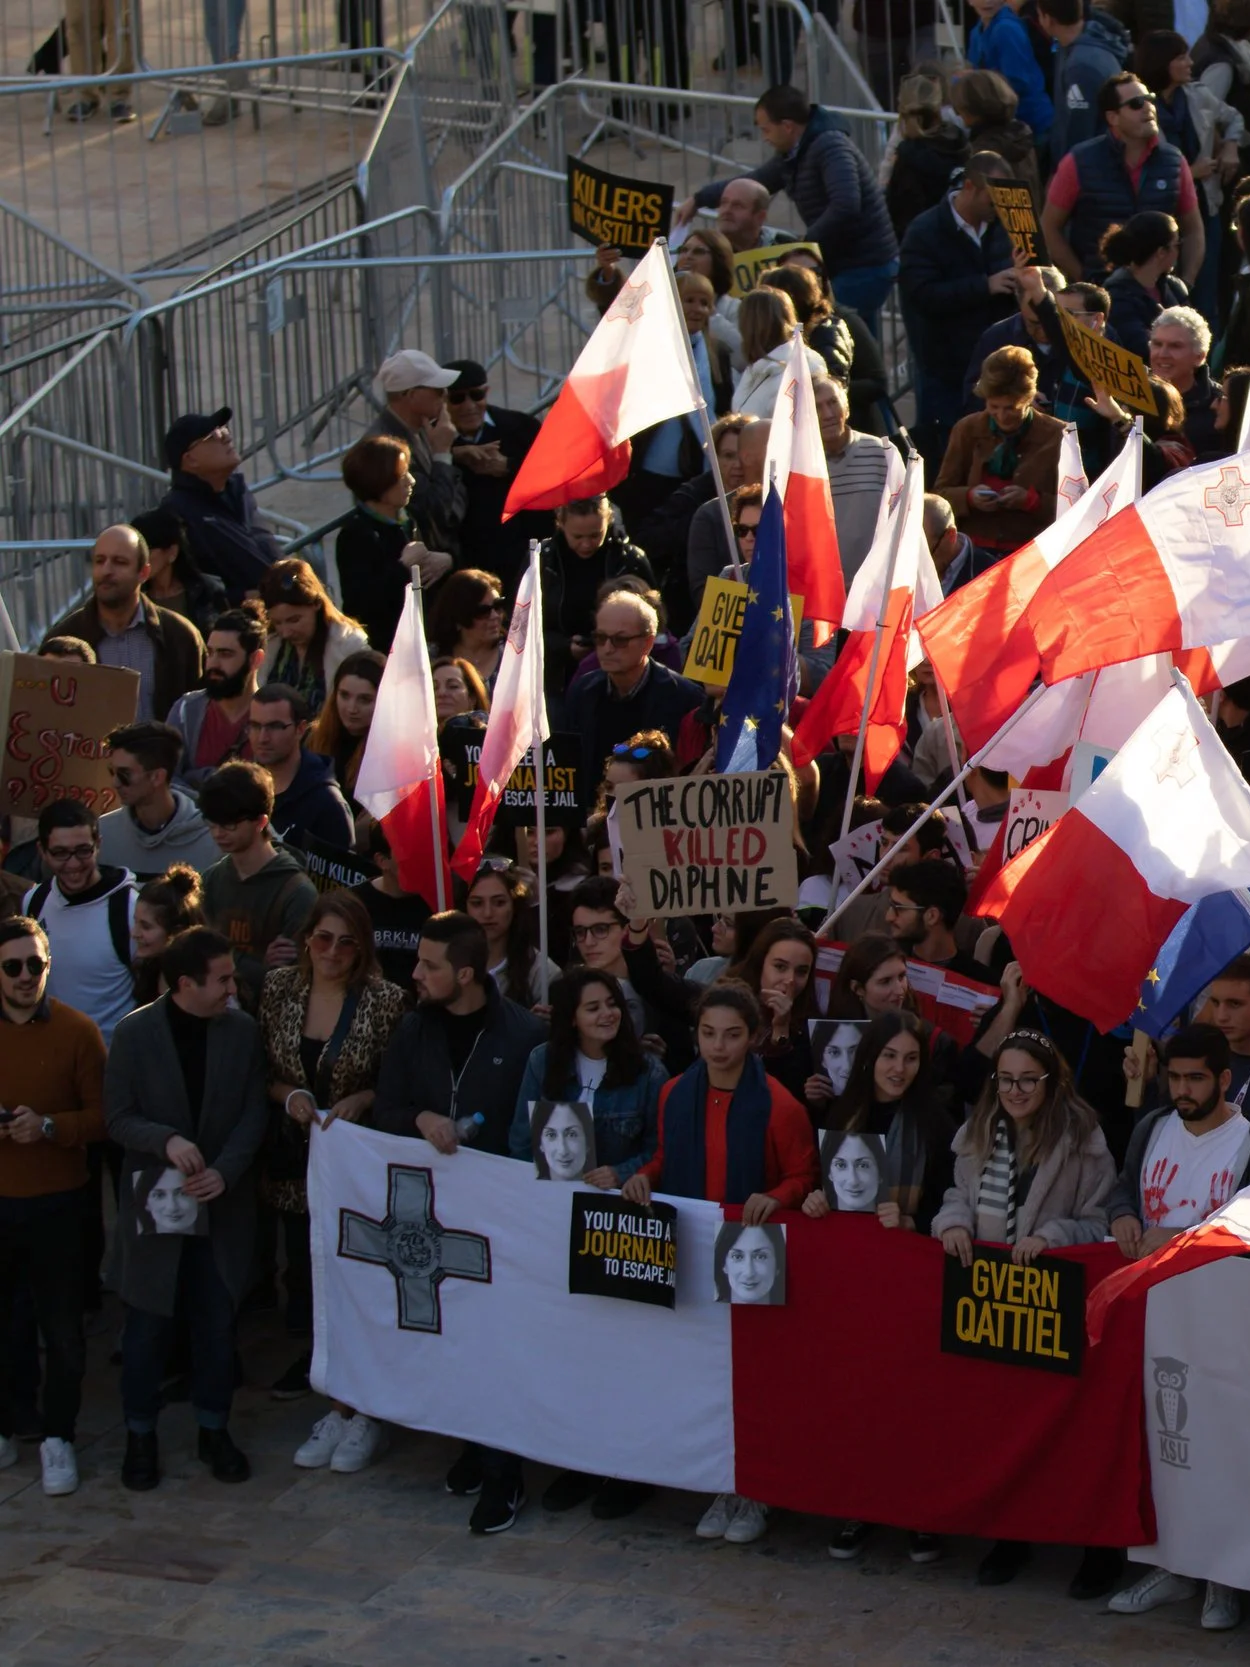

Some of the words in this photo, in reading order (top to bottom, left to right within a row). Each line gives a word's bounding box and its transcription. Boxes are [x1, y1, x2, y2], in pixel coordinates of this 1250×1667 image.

[574, 169, 662, 224] KILLERS
[546, 749, 556, 766] A
[504, 790, 549, 806] ESCAE
[553, 792, 578, 807] JAIL
[624, 785, 677, 830] THE
[680, 773, 788, 828] CORRUPT
[306, 851, 326, 875] YOU
[663, 826, 767, 867] KILLED
[650, 865, 778, 910] DAPHNE
[584, 1210, 613, 1231] YOU
[618, 1213, 662, 1239] KILLED
[665, 1222, 671, 1242] A
[578, 1230, 676, 1269] JOURNALIS
[604, 1258, 619, 1275] TO
[622, 1261, 664, 1284] ESCAPE
[972, 1259, 1059, 1310] GVERN
[956, 1297, 1069, 1360] QATTIEL
[1160, 1436, 1188, 1463] KSU
